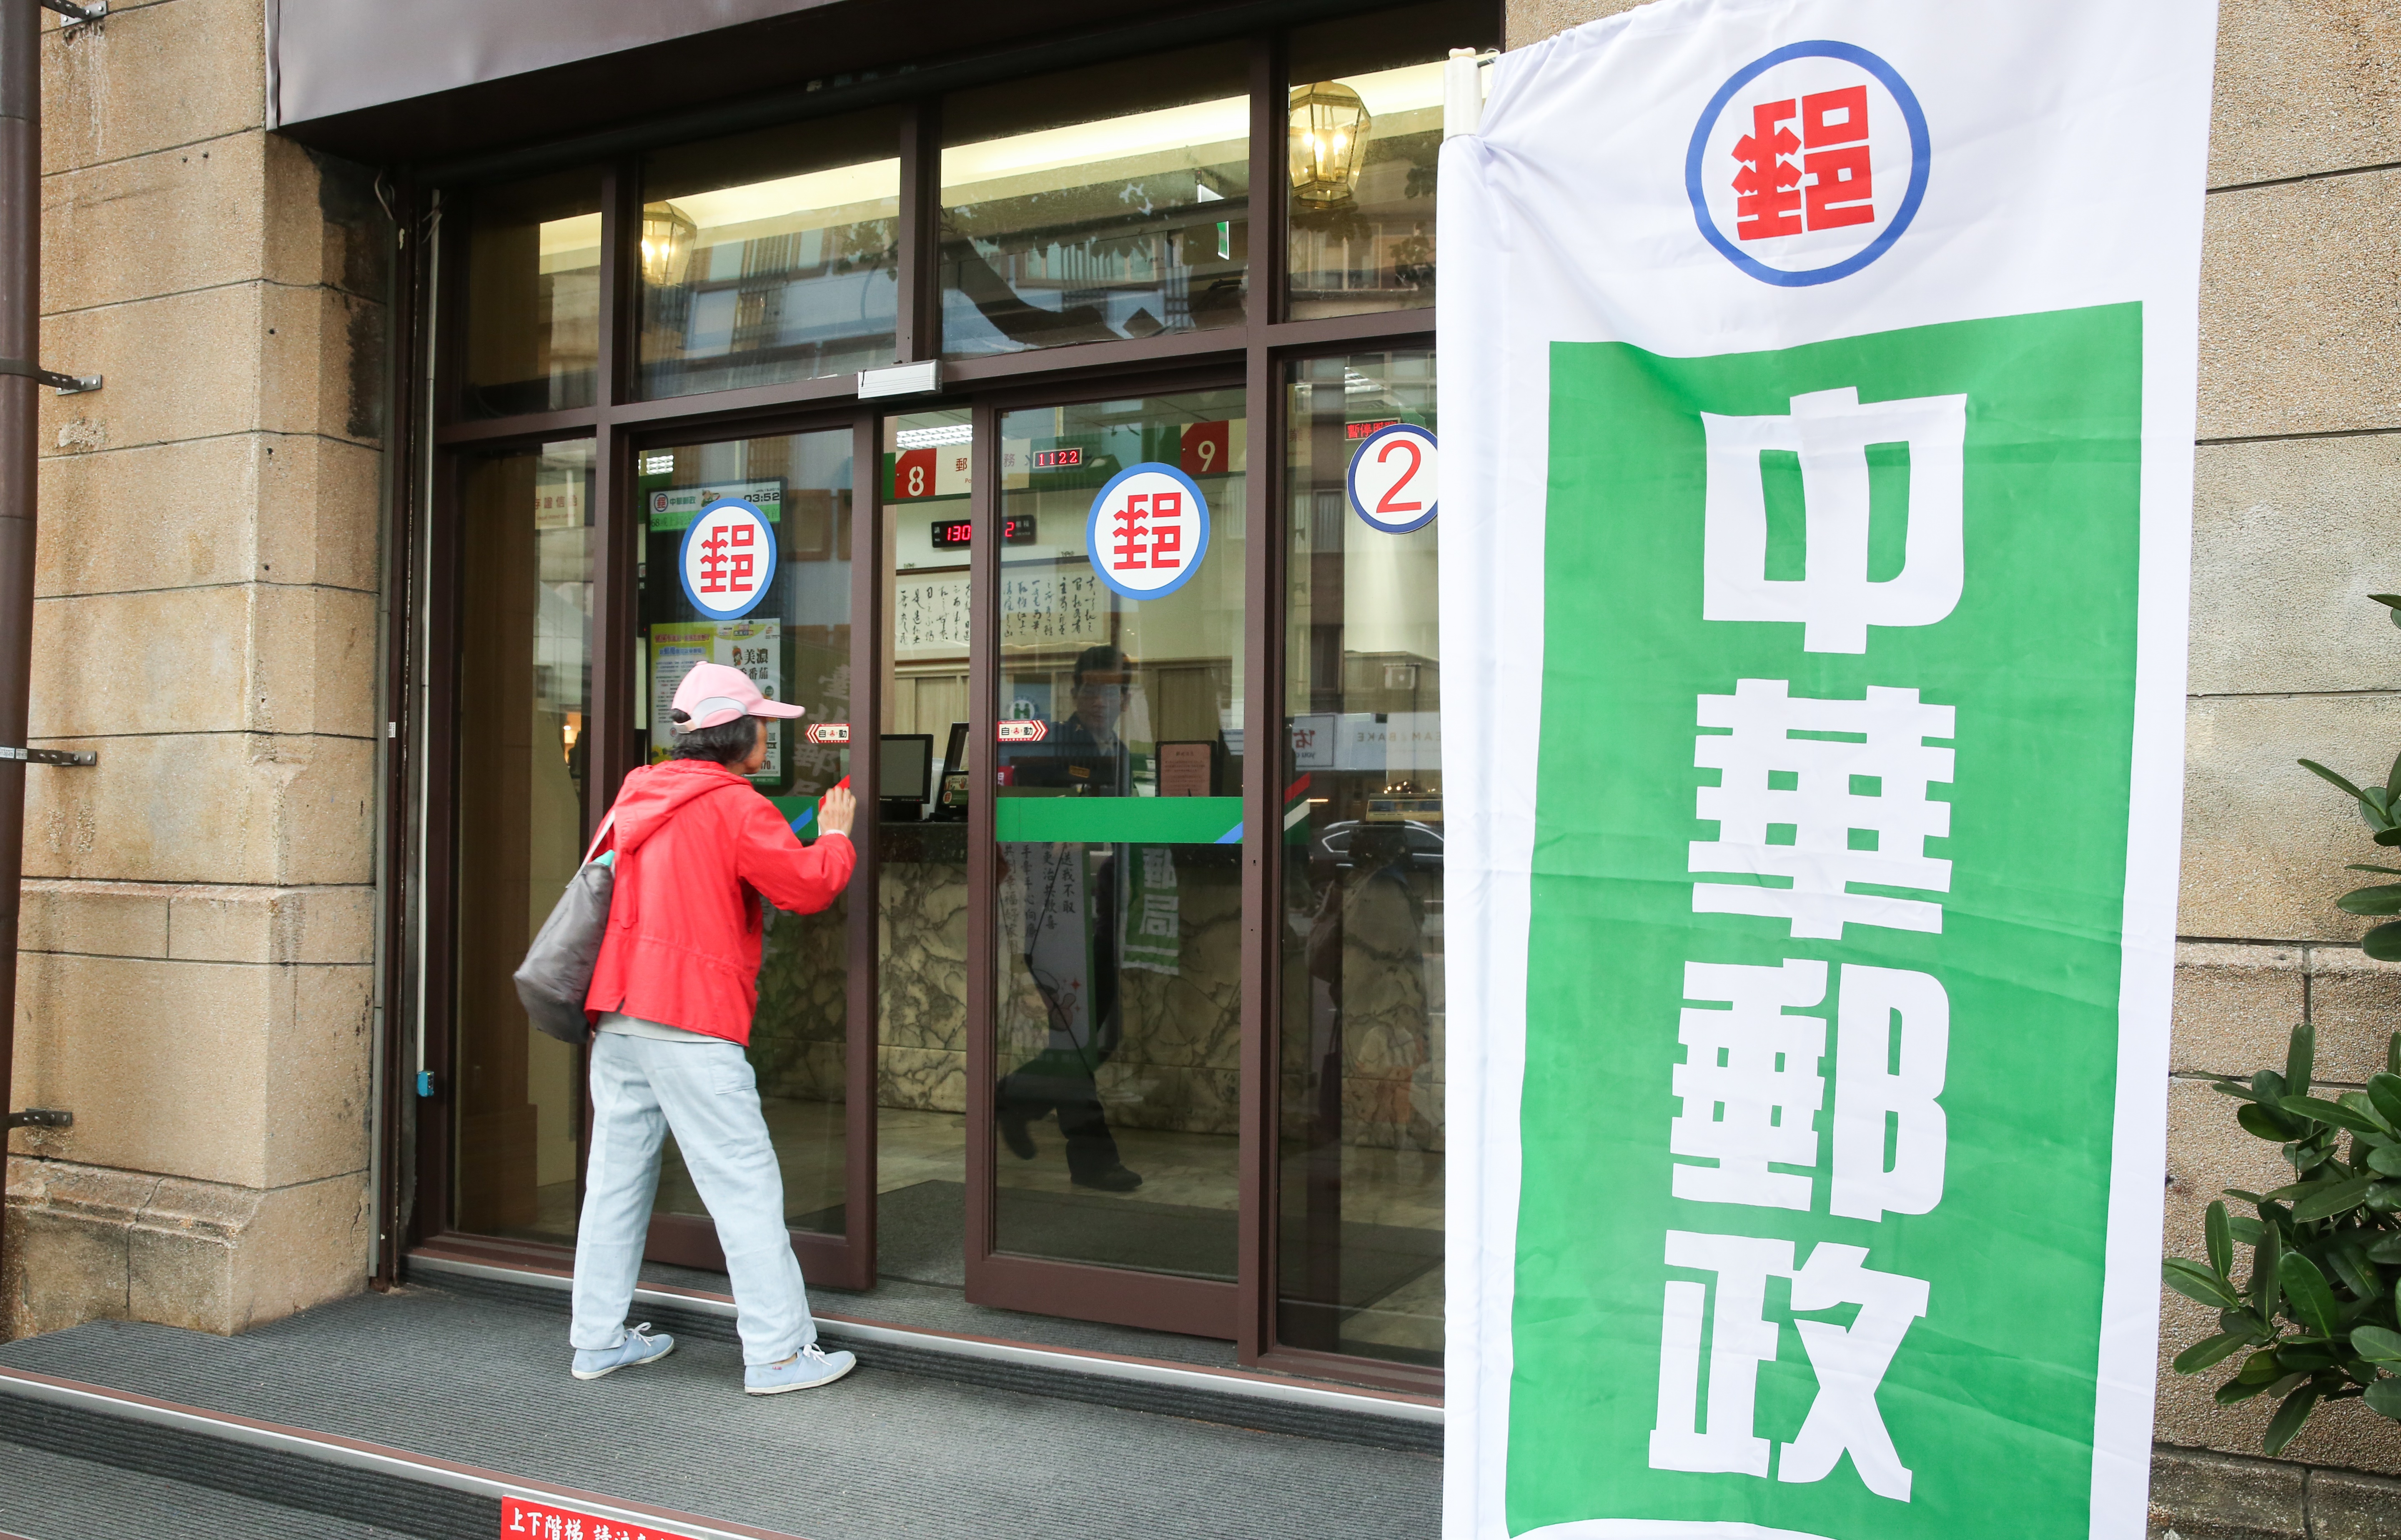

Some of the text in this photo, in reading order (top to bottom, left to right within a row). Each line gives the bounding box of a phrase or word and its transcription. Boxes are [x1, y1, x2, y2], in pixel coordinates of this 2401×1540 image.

[1731, 85, 1875, 240] 郵
[1348, 421, 1397, 439] 暫停服
[955, 453, 1015, 472] 郵 務
[1038, 450, 1078, 466] 1122
[1198, 440, 1216, 472] 9
[908, 466, 924, 496] 8
[1376, 439, 1422, 513] 2
[744, 493, 780, 503] 03:52
[947, 524, 971, 541] 130
[1004, 521, 1015, 537] 2
[1113, 492, 1182, 570] 郵
[700, 524, 754, 593] 郵
[744, 648, 768, 664] 美濃
[739, 667, 768, 679] 番茄
[1649, 386, 1968, 1505] 中華郵政
[509, 1507, 584, 1540] 上下階梯
